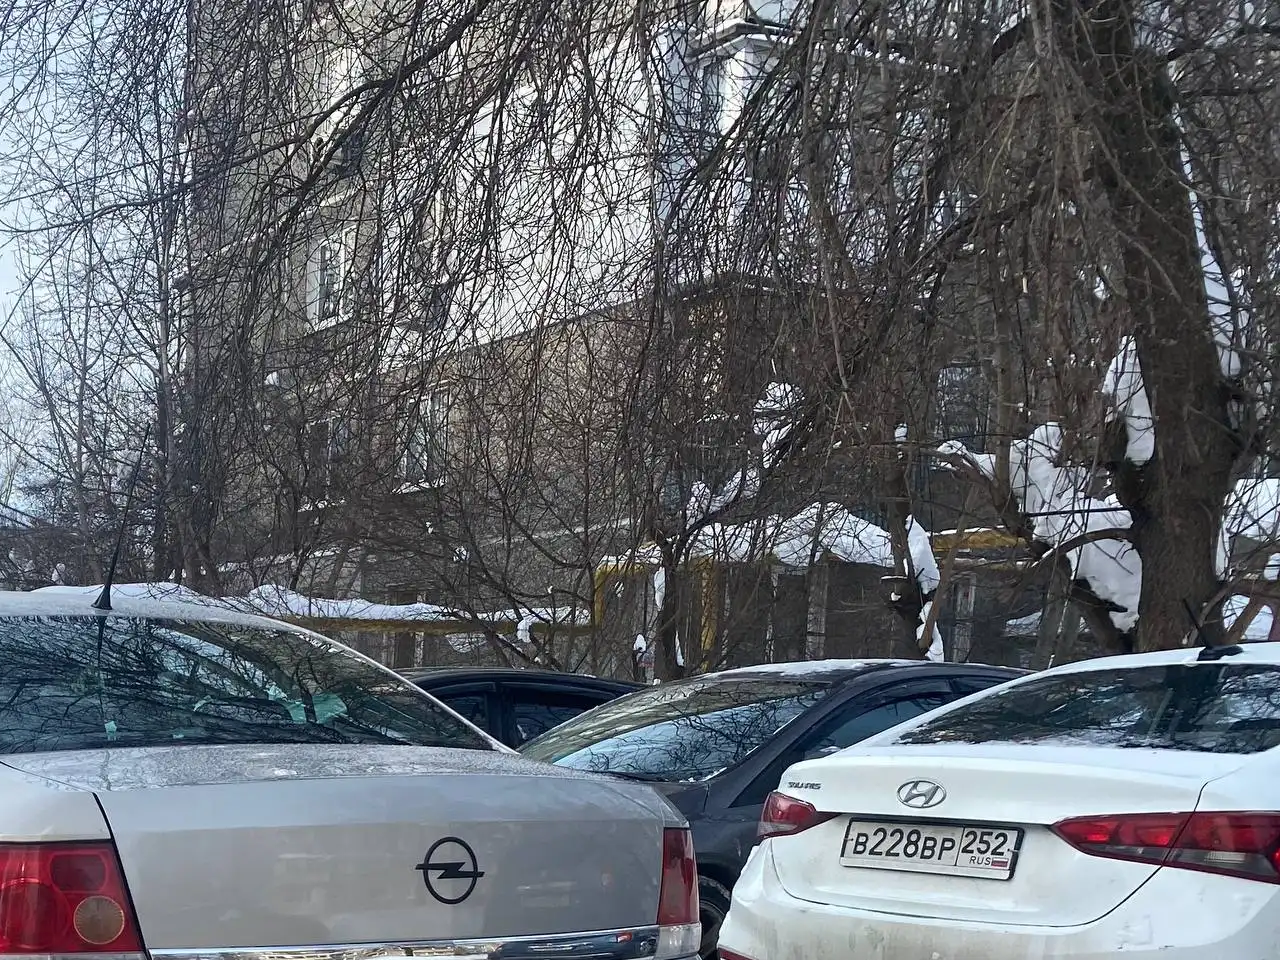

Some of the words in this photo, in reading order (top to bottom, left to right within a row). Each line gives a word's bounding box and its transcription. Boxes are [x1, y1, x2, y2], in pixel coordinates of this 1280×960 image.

[852, 827, 956, 860] В228ВР
[961, 830, 1008, 856] 252
[969, 855, 991, 866] RUS
